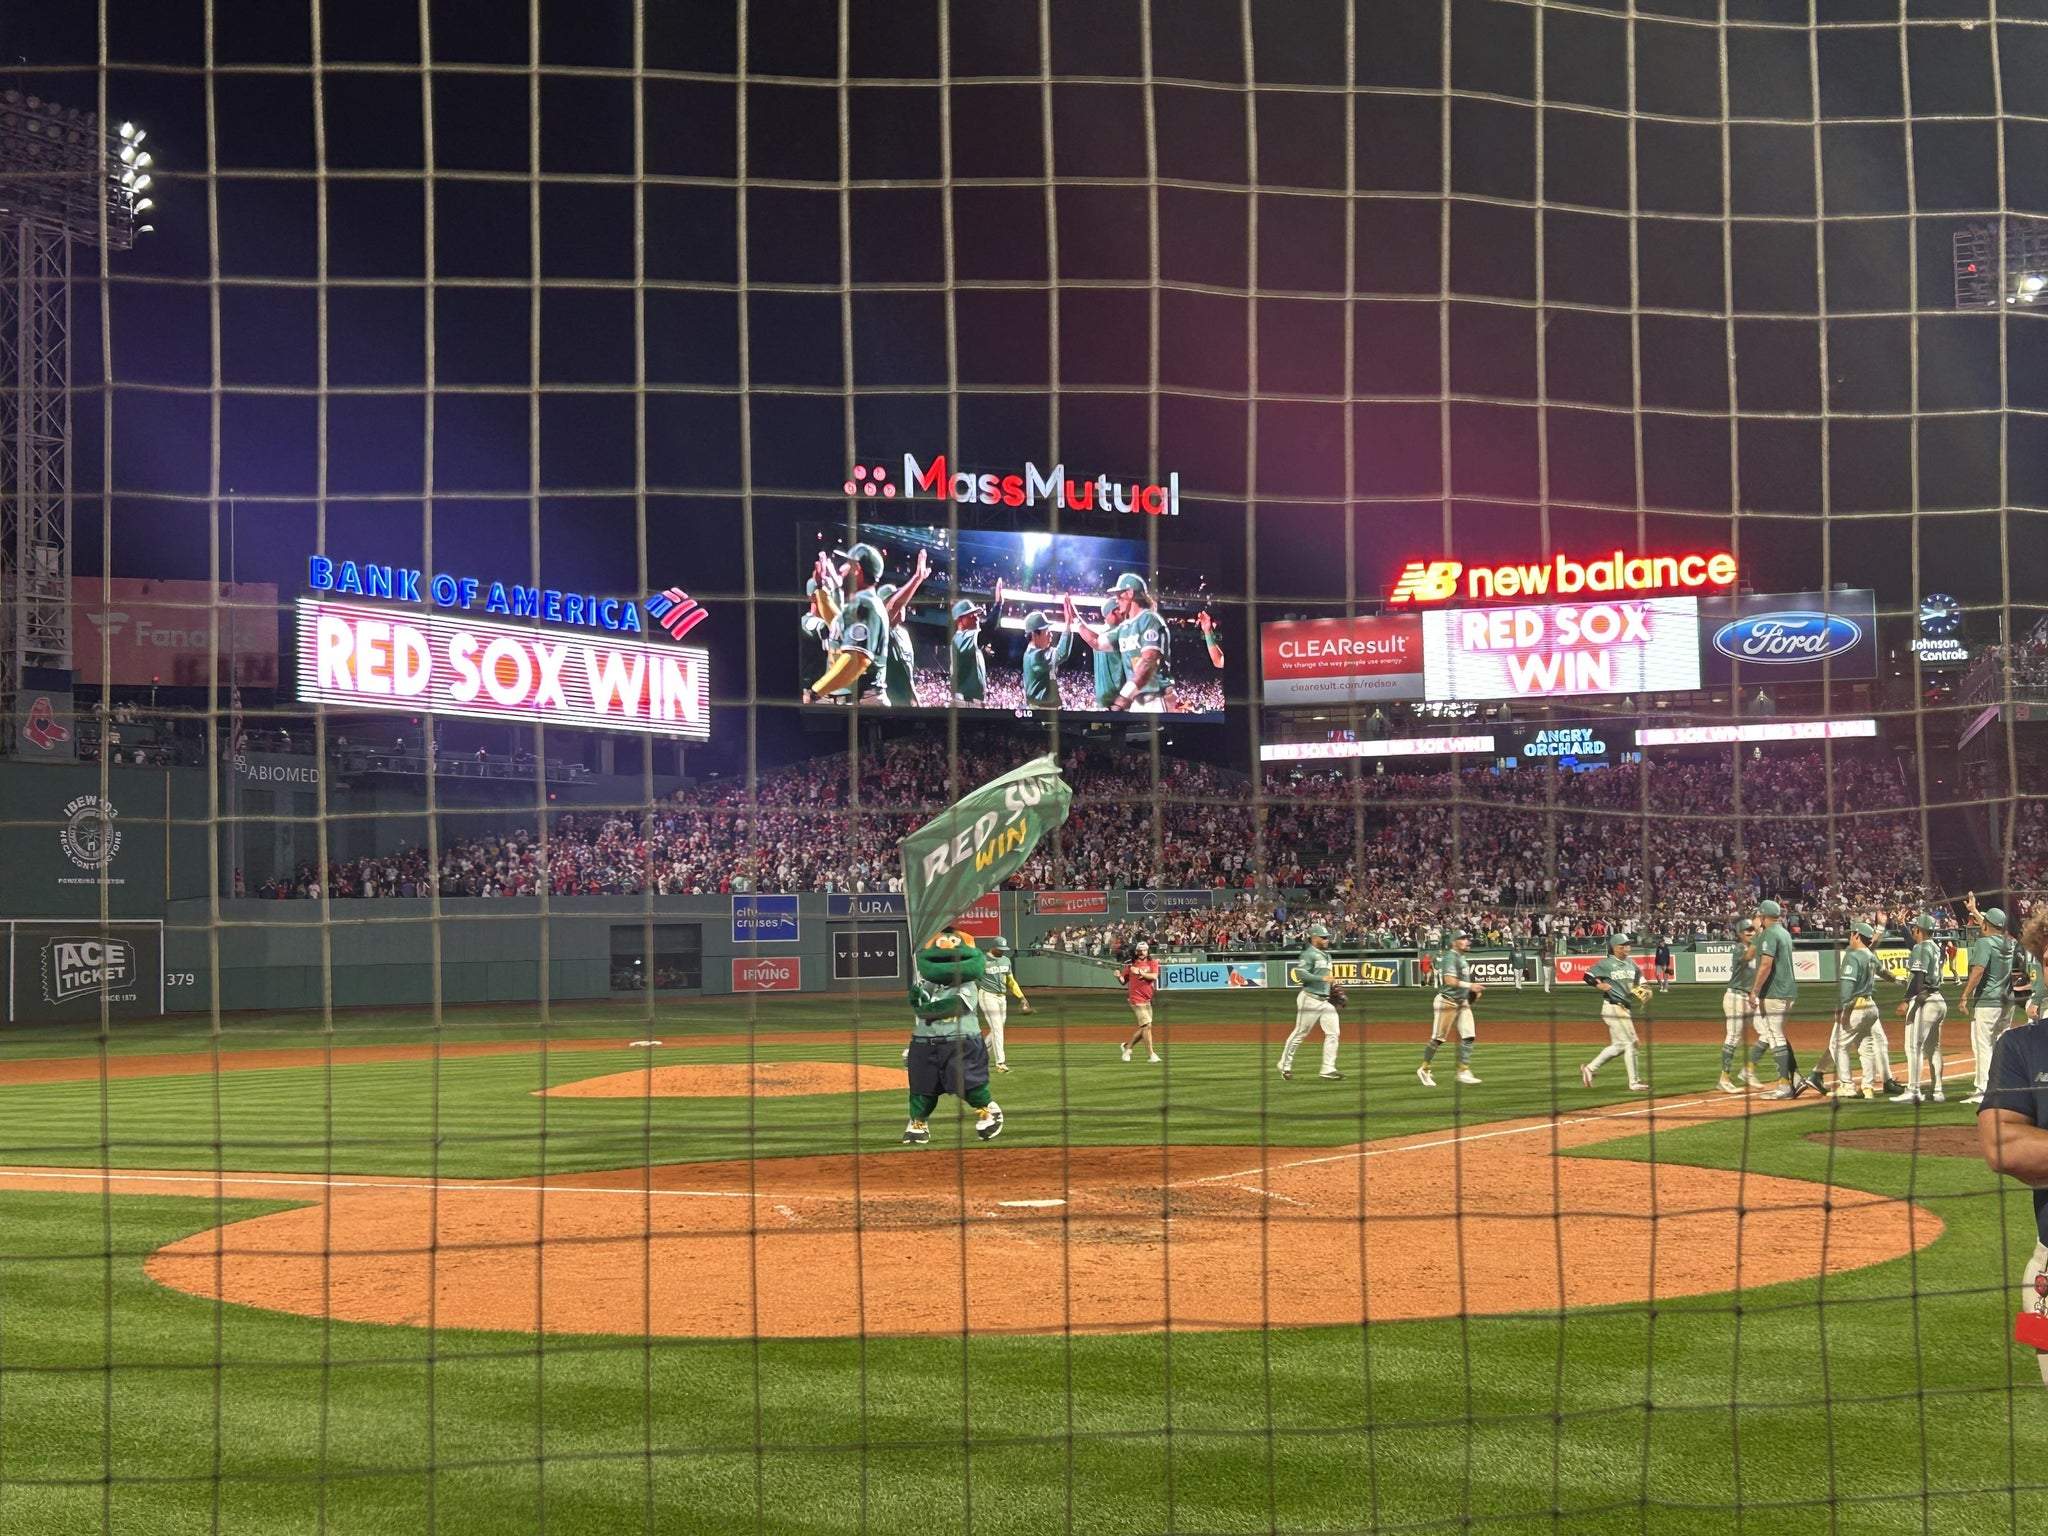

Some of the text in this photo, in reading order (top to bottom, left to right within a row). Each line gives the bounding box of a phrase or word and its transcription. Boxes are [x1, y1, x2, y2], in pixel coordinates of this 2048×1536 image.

[903, 452, 1179, 515] MassMutual
[1468, 550, 1738, 598] new balance
[309, 555, 642, 632] BANK OF AMERICA
[1462, 602, 1652, 651] RED SOX
[1742, 621, 1831, 655] Ford
[1911, 638, 1960, 651] Johnson
[1920, 648, 1969, 661] Controls
[316, 615, 701, 723] RED SOX WIN
[1508, 650, 1611, 692] WIN
[1536, 728, 1593, 743] ANGRY
[1524, 740, 1606, 757] ORCHARD
[248, 765, 320, 783] ABIOMED
[63, 795, 119, 819] IBEW 103
[923, 811, 999, 888] RED
[975, 818, 1027, 873] WIN
[736, 917, 778, 928] cruises
[837, 951, 895, 959] VOLVO
[61, 942, 126, 989] ACE TICKET
[743, 968, 790, 980] IRVING
[1361, 962, 1396, 982] CITY
[1698, 965, 1727, 973] BANK
[167, 973, 195, 986] 379
[1165, 967, 1219, 987] jetBlue
